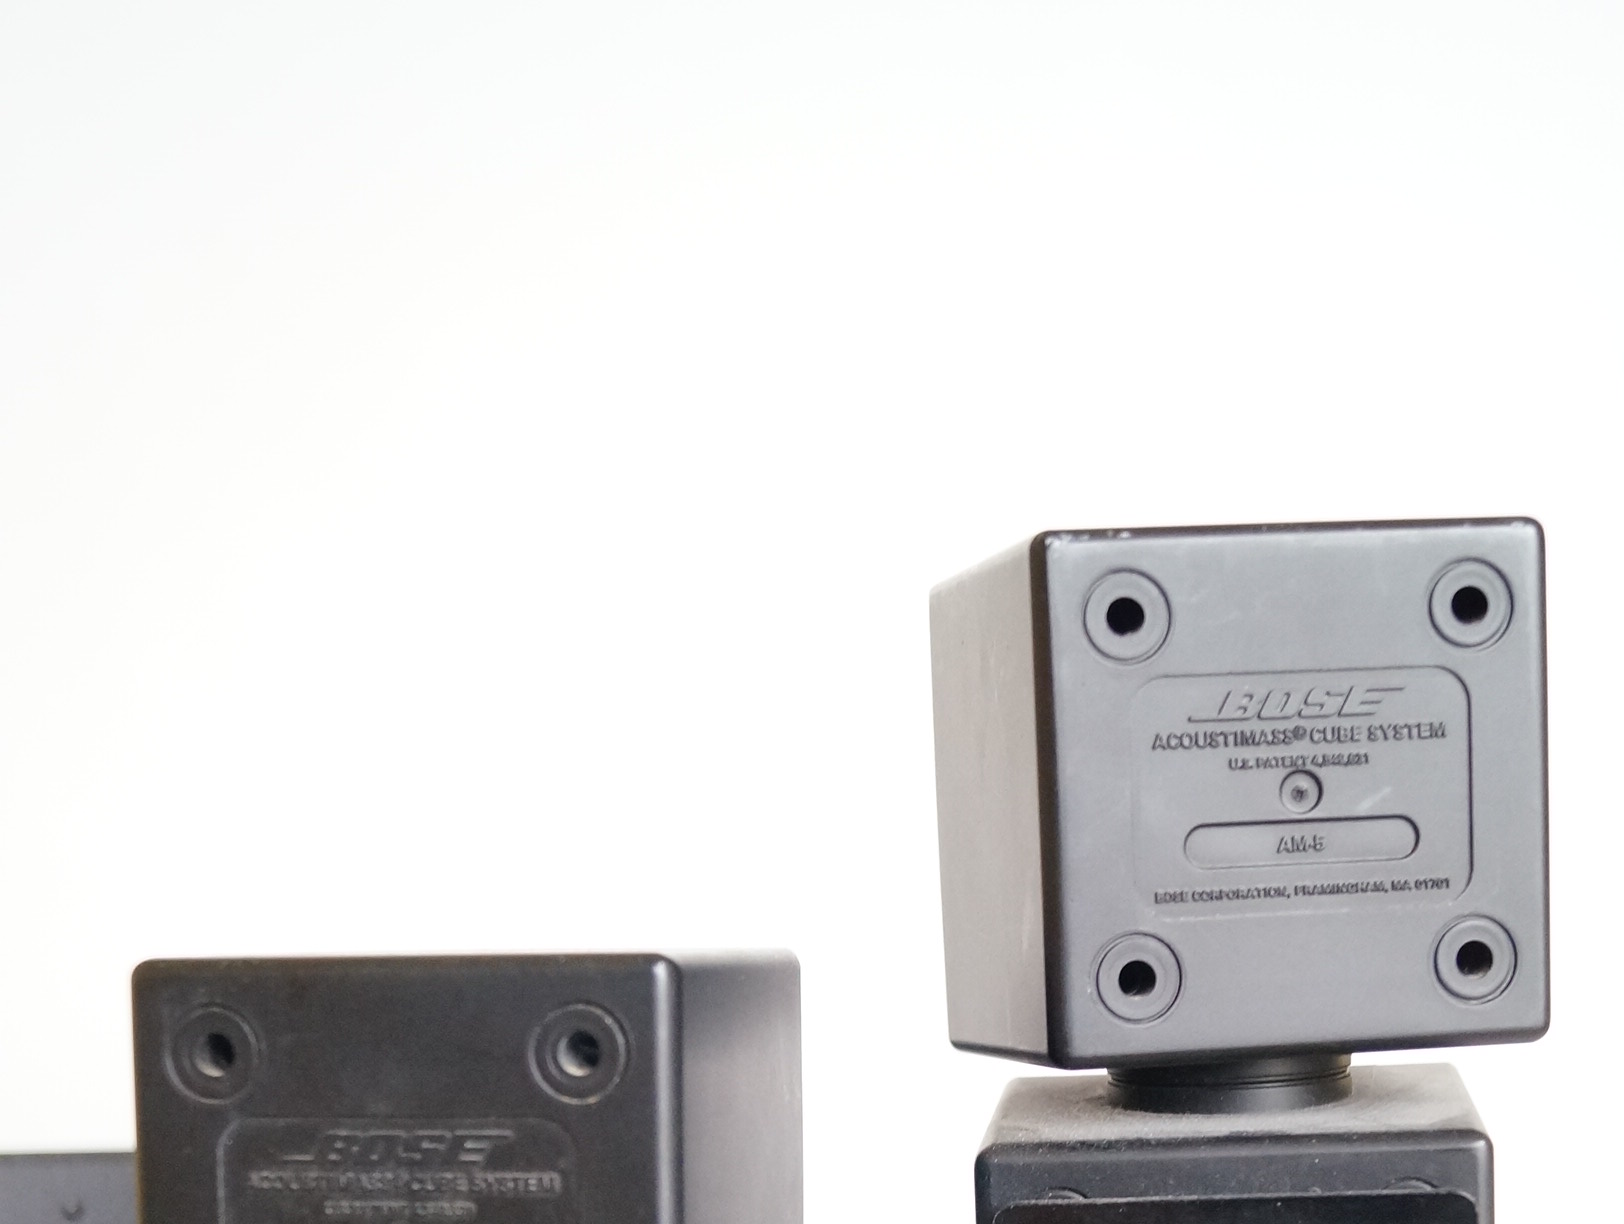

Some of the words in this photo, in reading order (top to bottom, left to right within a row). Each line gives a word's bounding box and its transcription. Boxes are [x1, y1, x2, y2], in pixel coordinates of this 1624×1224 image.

[1188, 685, 1406, 722] BOSE
[1309, 724, 1362, 745] CUBE
[1366, 721, 1448, 741] SYSTEM
